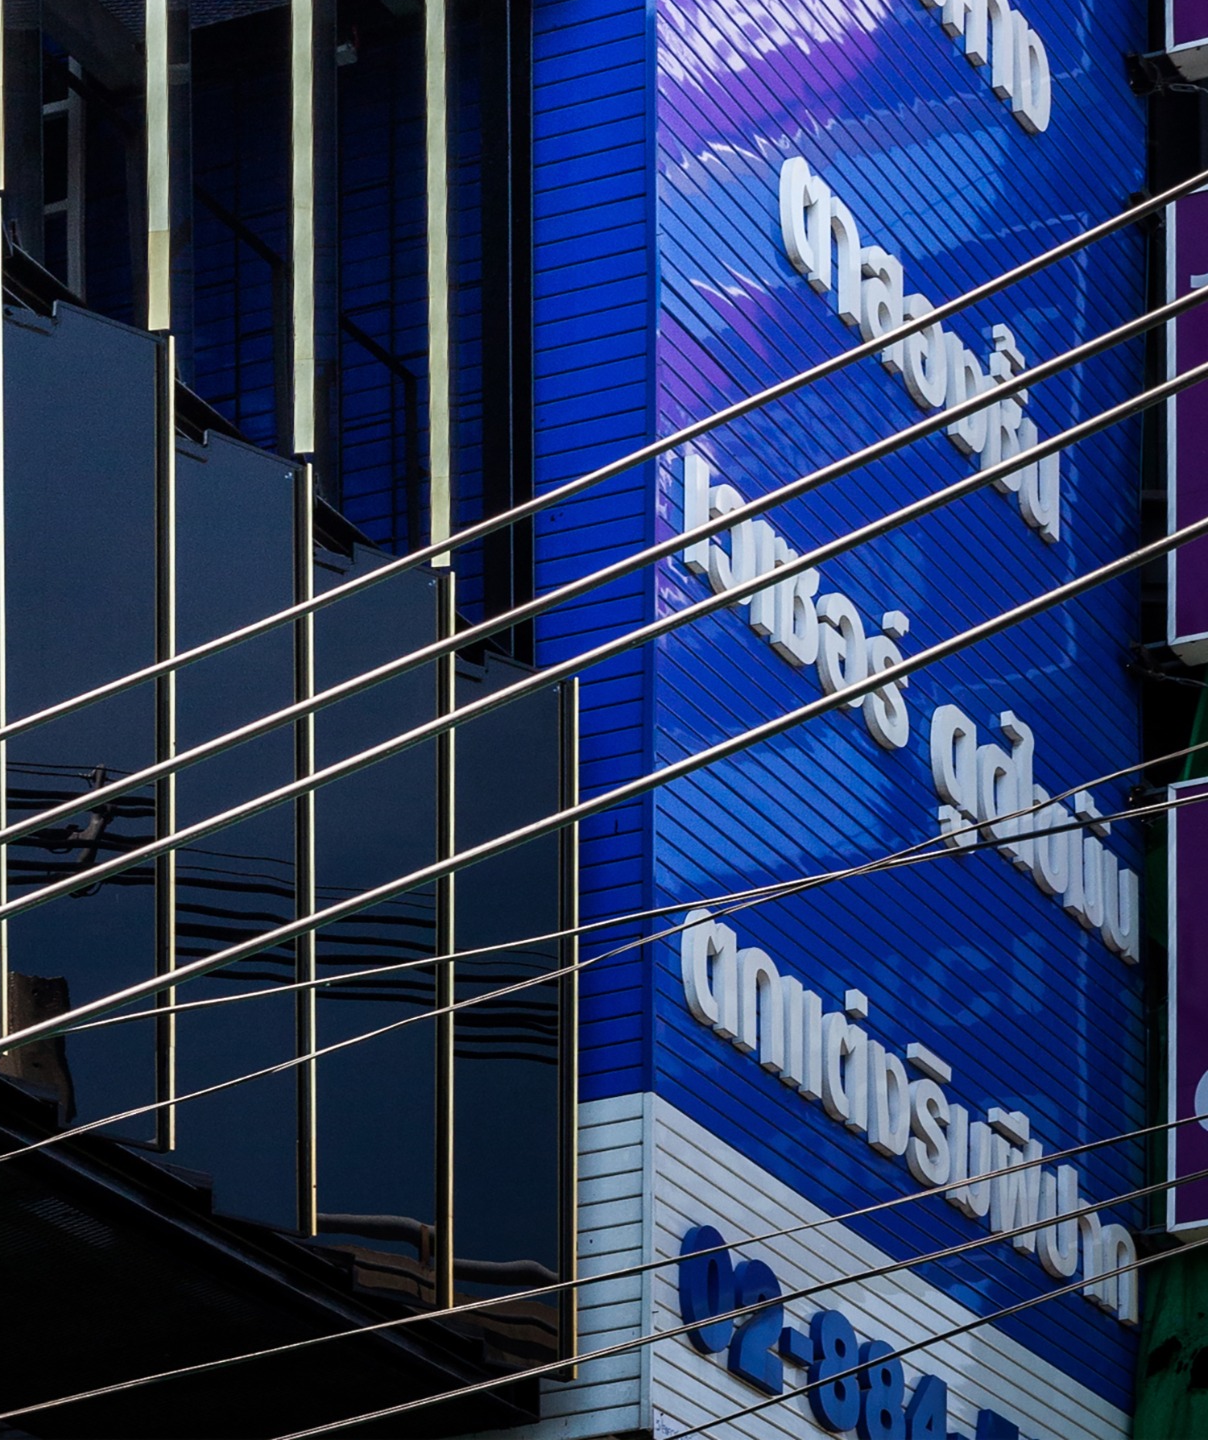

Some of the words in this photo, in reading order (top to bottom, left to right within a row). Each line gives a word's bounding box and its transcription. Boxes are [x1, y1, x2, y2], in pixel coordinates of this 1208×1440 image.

[779, 155, 1061, 543] ตาสองชั้น
[683, 453, 911, 752] เวเซอร์
[929, 703, 1141, 965] ดูดไขมัน
[681, 908, 1139, 1327] ตกแต่งริมฝีปาก
